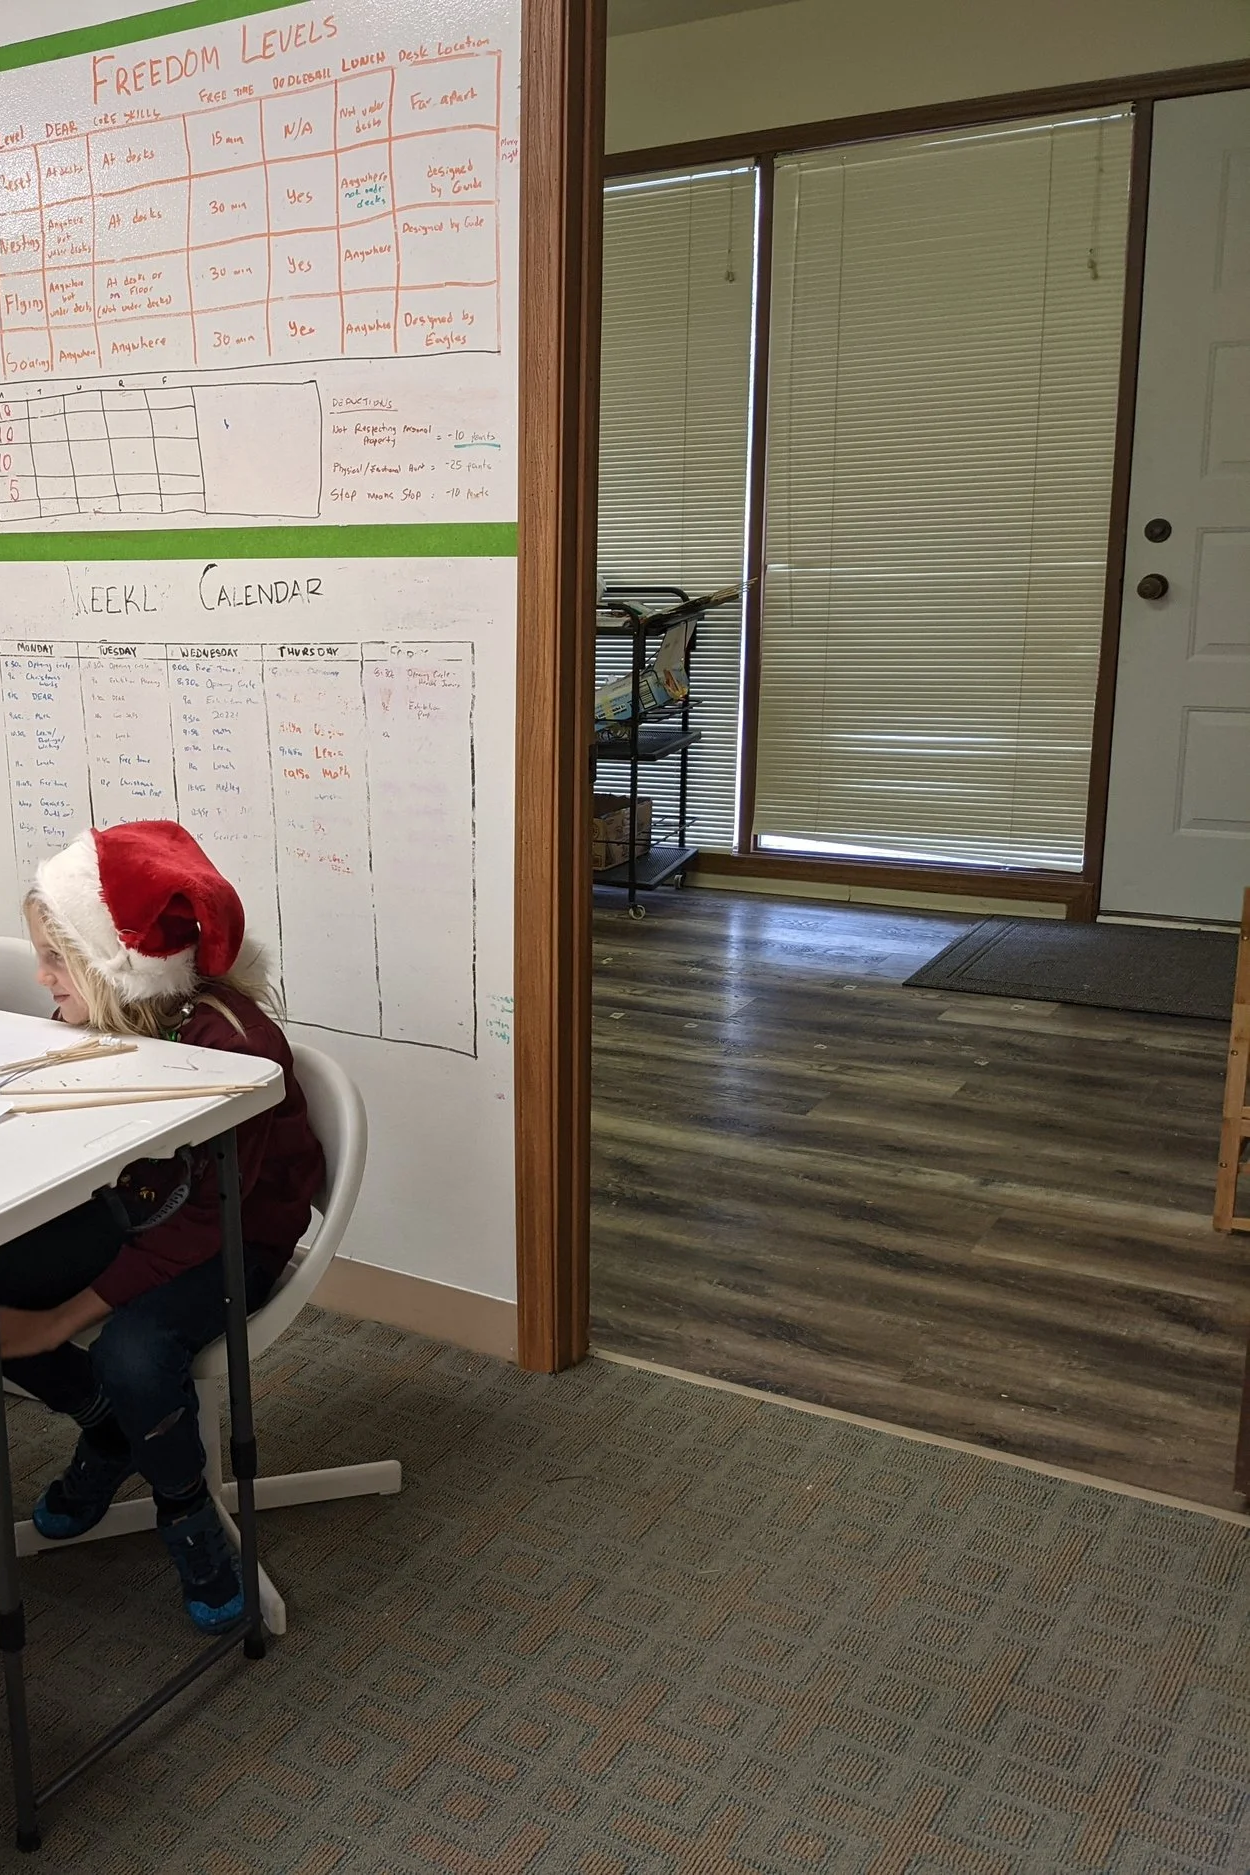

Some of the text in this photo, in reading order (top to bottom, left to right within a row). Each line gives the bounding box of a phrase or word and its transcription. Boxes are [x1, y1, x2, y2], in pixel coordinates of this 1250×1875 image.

[92, 15, 338, 105] FREEDOM LEVELS
[45, 120, 78, 138] DEAR
[341, 52, 386, 73] LUNCH
[437, 36, 490, 57] Location
[284, 117, 313, 141] N/A
[427, 158, 474, 180] designed
[286, 189, 313, 204] Yes
[286, 256, 313, 274] Yes
[5, 294, 45, 315] Flying
[110, 336, 167, 355] Anywhere
[5, 352, 51, 374] Soaring
[354, 422, 397, 436] Respecting
[10, 479, 20, 502] 5
[330, 487, 357, 501] Stop
[400, 487, 423, 501] Stop
[199, 563, 324, 610] CALENDAR
[17, 642, 340, 659] MONDAY TUESDAY WEDNESDAY THURSDAY
